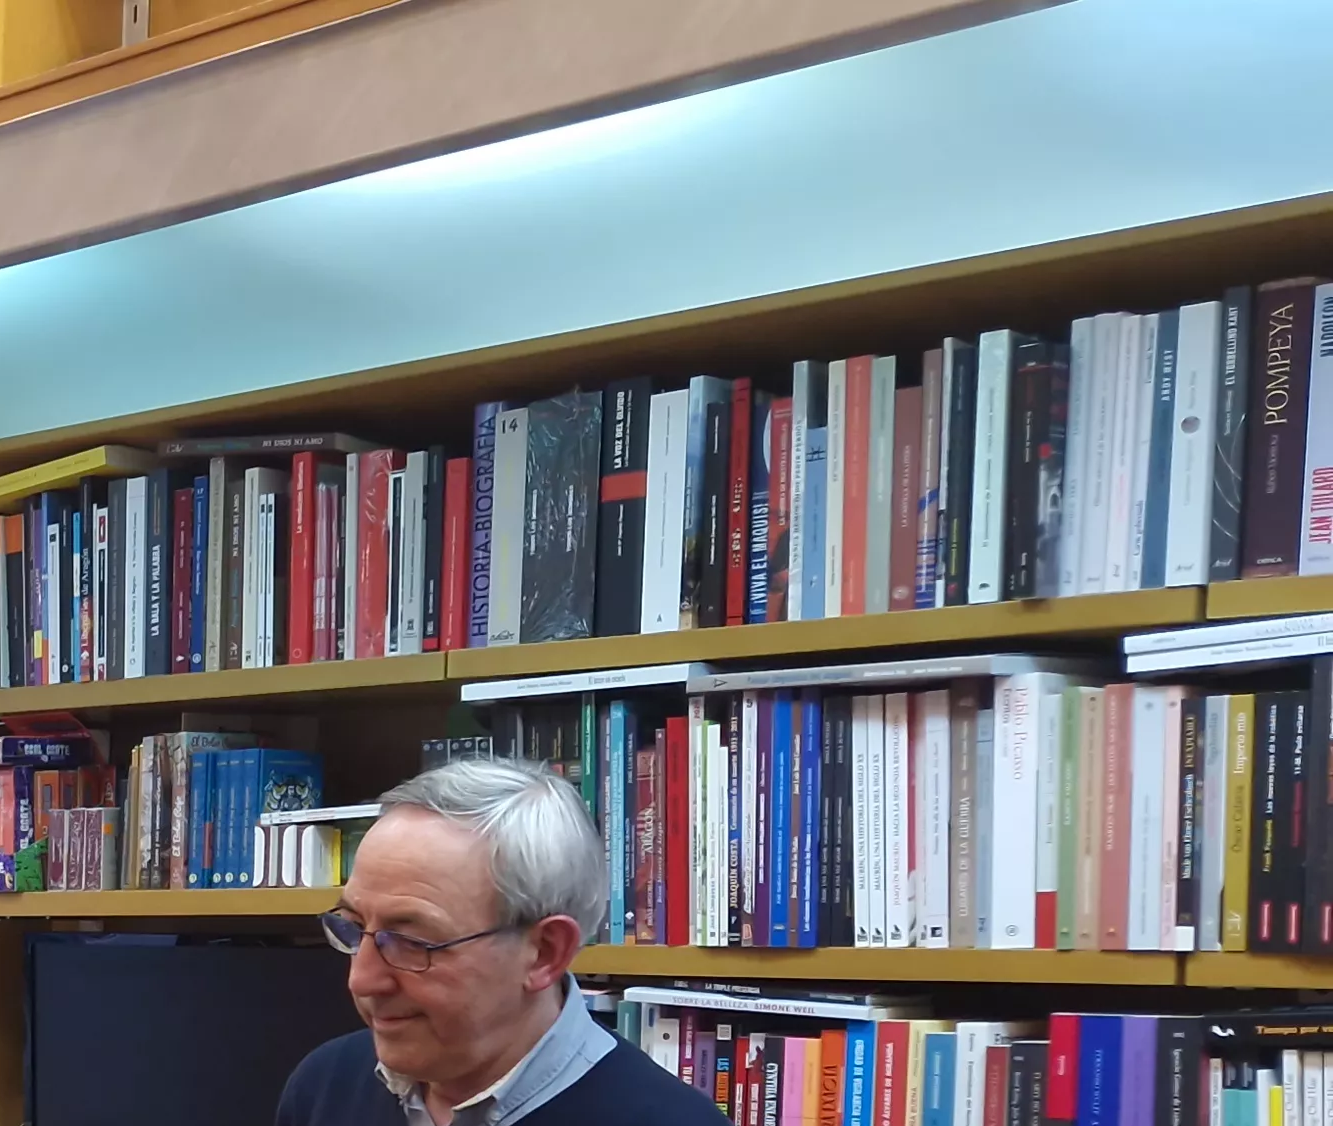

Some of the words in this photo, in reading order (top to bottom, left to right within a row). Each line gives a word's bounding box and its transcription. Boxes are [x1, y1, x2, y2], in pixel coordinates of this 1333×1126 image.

[1227, 306, 1239, 326] KANT
[1162, 349, 1174, 373] WEST
[1263, 303, 1294, 426] POMPEYA
[500, 418, 519, 434] 14
[614, 439, 623, 456] VOZ
[751, 502, 769, 552] MAQUIS!
[1308, 516, 1332, 545] JEAN
[80, 548, 92, 585] Aragón
[152, 545, 161, 581] PALABRA
[751, 555, 768, 569] EL
[152, 582, 161, 594] LA
[750, 572, 768, 604] ¡VIVA
[151, 603, 160, 623] BALA
[151, 624, 160, 637] LA
[1013, 687, 1029, 726] Pablo
[1012, 731, 1028, 780] Picasso
[1233, 735, 1248, 774] Imperio
[1294, 735, 1303, 754] Pudo
[857, 753, 866, 763] XX
[872, 753, 881, 763] XX
[857, 764, 866, 787] SIGLO
[872, 764, 881, 787] SIGLO
[857, 787, 866, 803] DEL
[872, 787, 881, 803] DEL
[643, 807, 655, 854] ARAGÓN
[857, 804, 866, 840] HISTORIA
[873, 804, 881, 840] HISTORIA
[729, 838, 738, 867] COSTA
[729, 868, 739, 909] JOAQUÍN
[672, 996, 699, 1005] SOBRE
[714, 1000, 748, 1009] BELLEZA
[754, 1002, 790, 1012] SIMONE
[794, 1005, 816, 1014] WEIL
[717, 1058, 730, 1071] LAS
[765, 1062, 778, 1099] CYNTHIA
[822, 1064, 838, 1113] EXACTA
